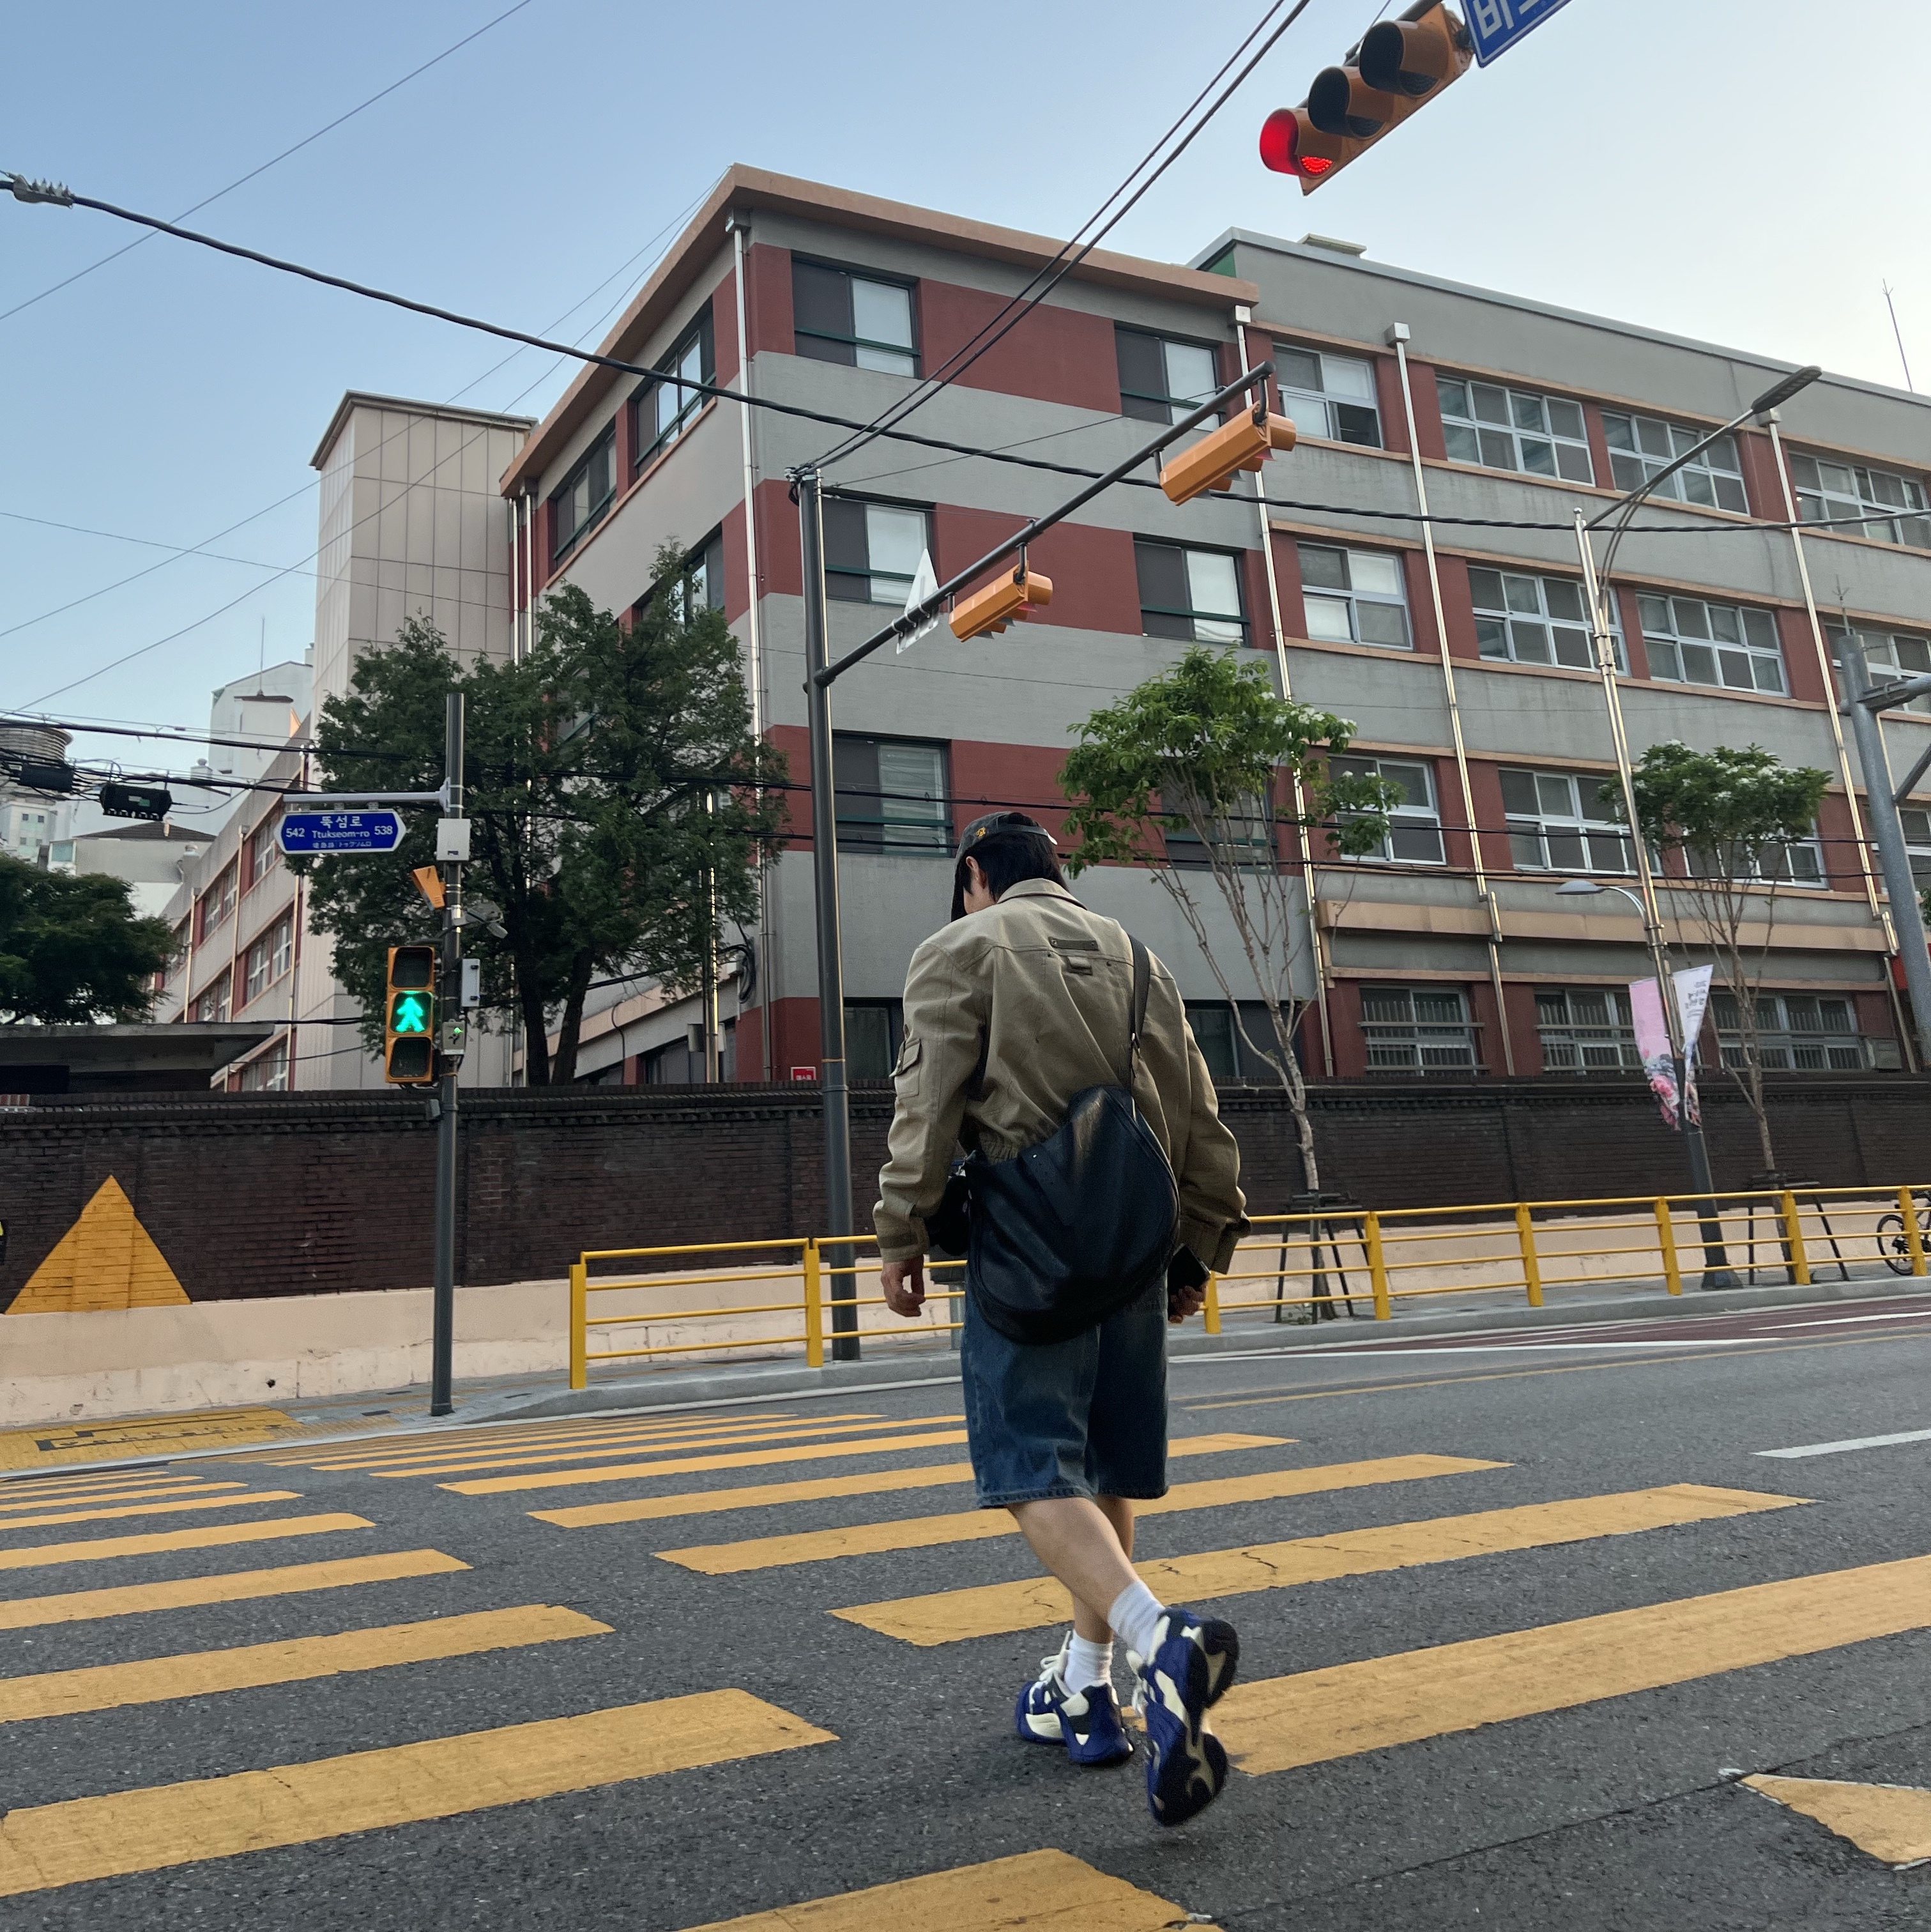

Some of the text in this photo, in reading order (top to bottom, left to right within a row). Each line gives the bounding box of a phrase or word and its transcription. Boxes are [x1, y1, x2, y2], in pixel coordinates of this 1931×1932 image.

[320, 815, 363, 829] 뚝섬로
[286, 828, 305, 838] 542
[312, 830, 370, 839] Ttukseom-ro
[374, 825, 393, 835] 538
